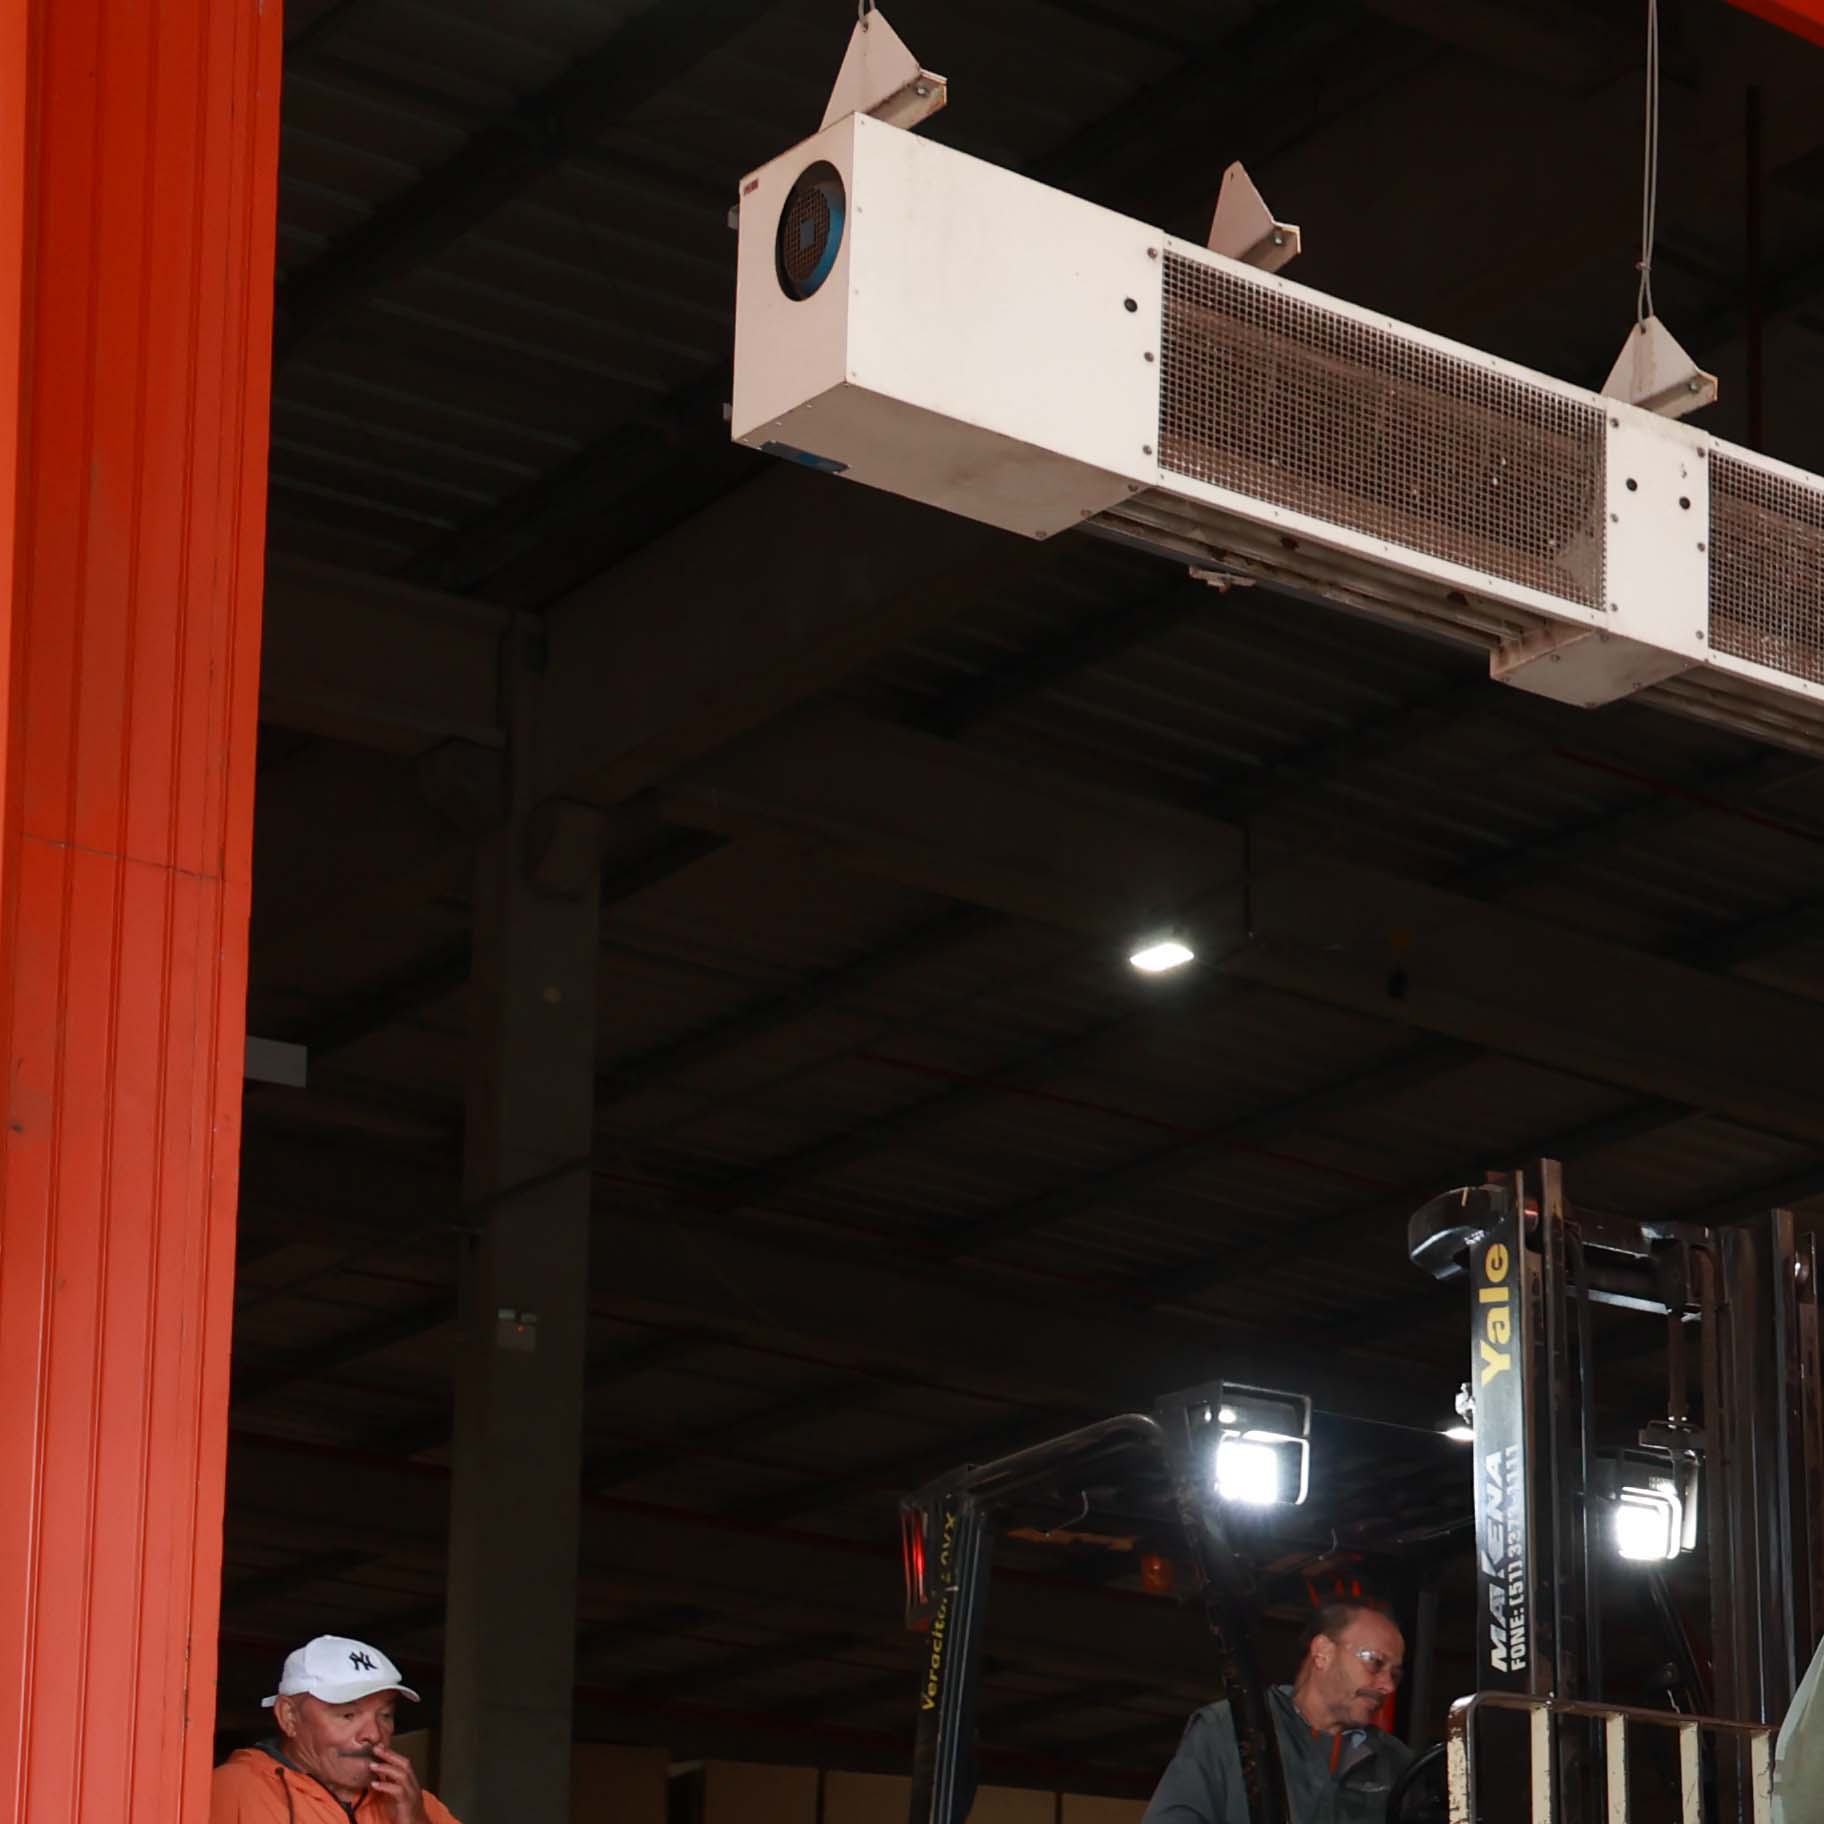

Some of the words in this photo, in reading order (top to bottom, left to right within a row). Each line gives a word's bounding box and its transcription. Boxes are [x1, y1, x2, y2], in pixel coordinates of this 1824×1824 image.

[1479, 1243, 1511, 1388] Yale
[1481, 1450, 1508, 1673] MAKENA
[1508, 1607, 1527, 1672] FONE:
